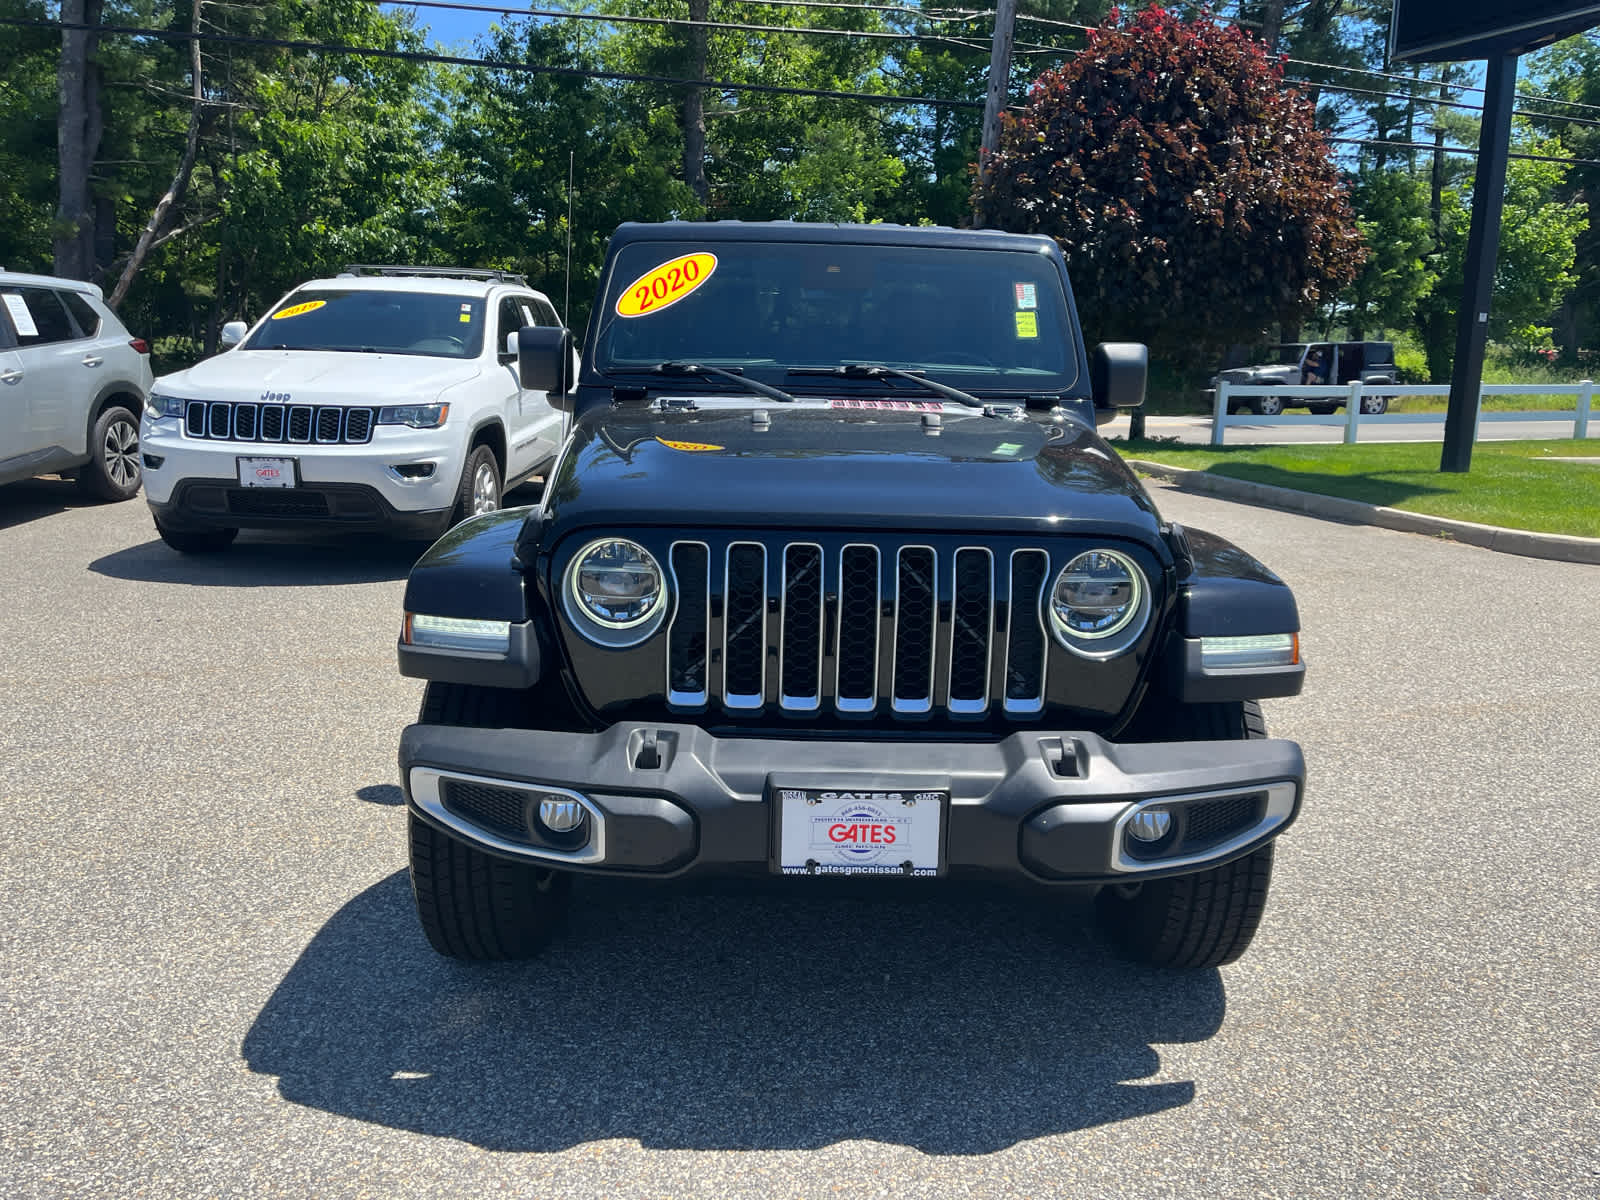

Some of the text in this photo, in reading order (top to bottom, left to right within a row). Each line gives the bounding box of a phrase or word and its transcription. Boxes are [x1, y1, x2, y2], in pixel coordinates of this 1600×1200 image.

[636, 260, 699, 310] 2020
[261, 391, 291, 402] Jeep
[256, 469, 280, 478] GATES
[820, 792, 903, 800] GATES
[828, 824, 896, 844] GATES
[814, 865, 904, 876] gatesgmcnissan
